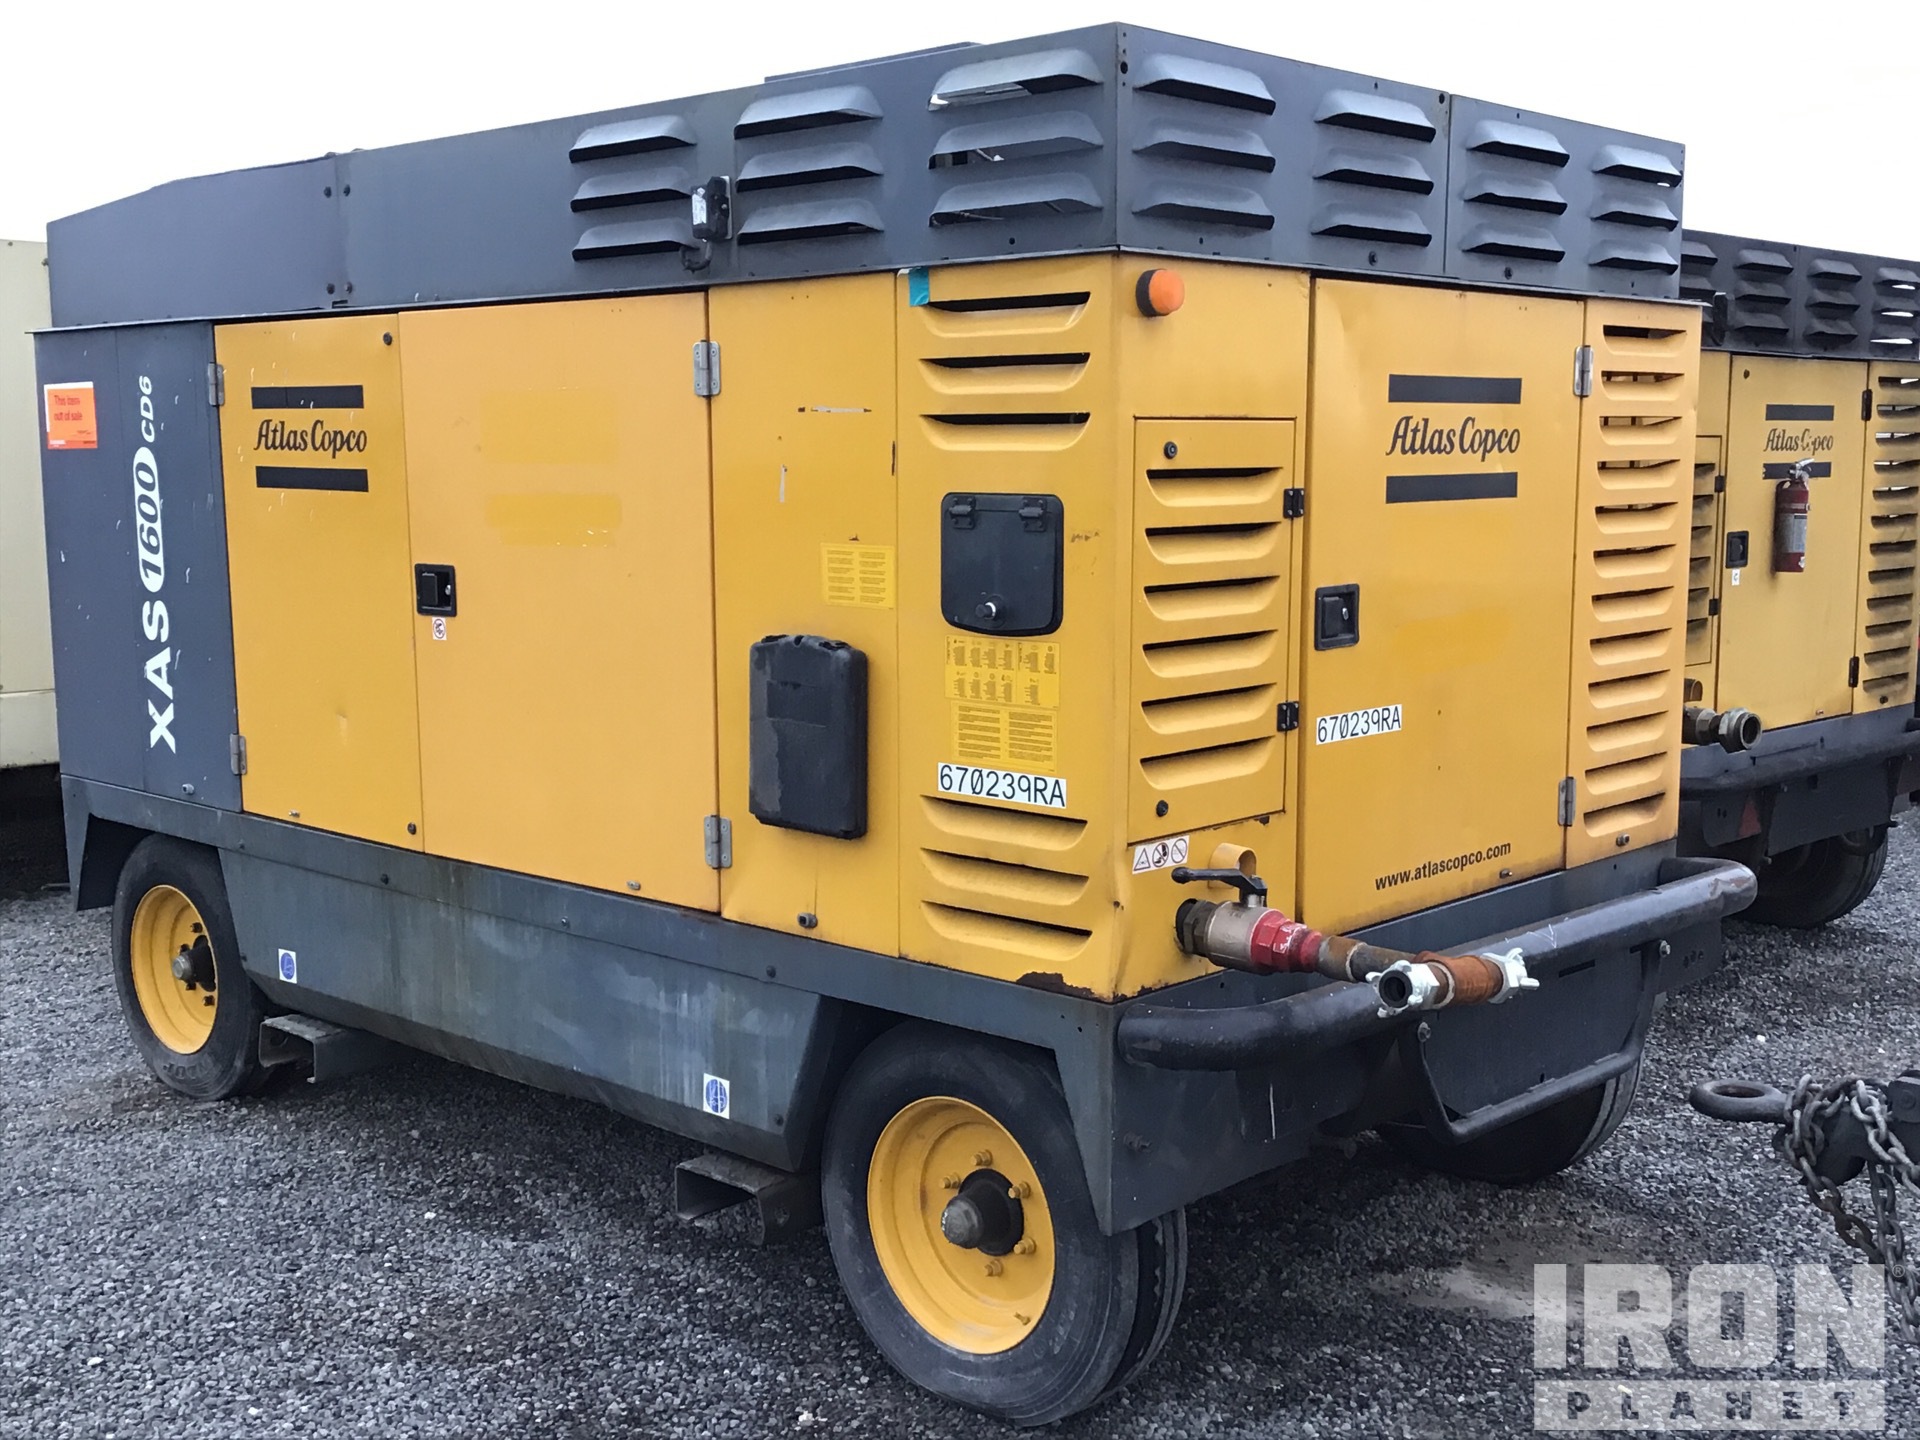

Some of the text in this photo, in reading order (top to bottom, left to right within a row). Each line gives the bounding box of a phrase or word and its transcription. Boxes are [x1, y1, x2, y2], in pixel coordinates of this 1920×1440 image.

[253, 418, 367, 459] Atlas Copco
[1385, 415, 1521, 463] Atlas Copco
[1763, 427, 1800, 452] Atlas
[135, 375, 176, 754] XAS 1600 CD6
[1317, 706, 1401, 743] 670239RA
[940, 765, 1066, 807] 670239RA
[1375, 843, 1511, 891] www.atlascopco.com
